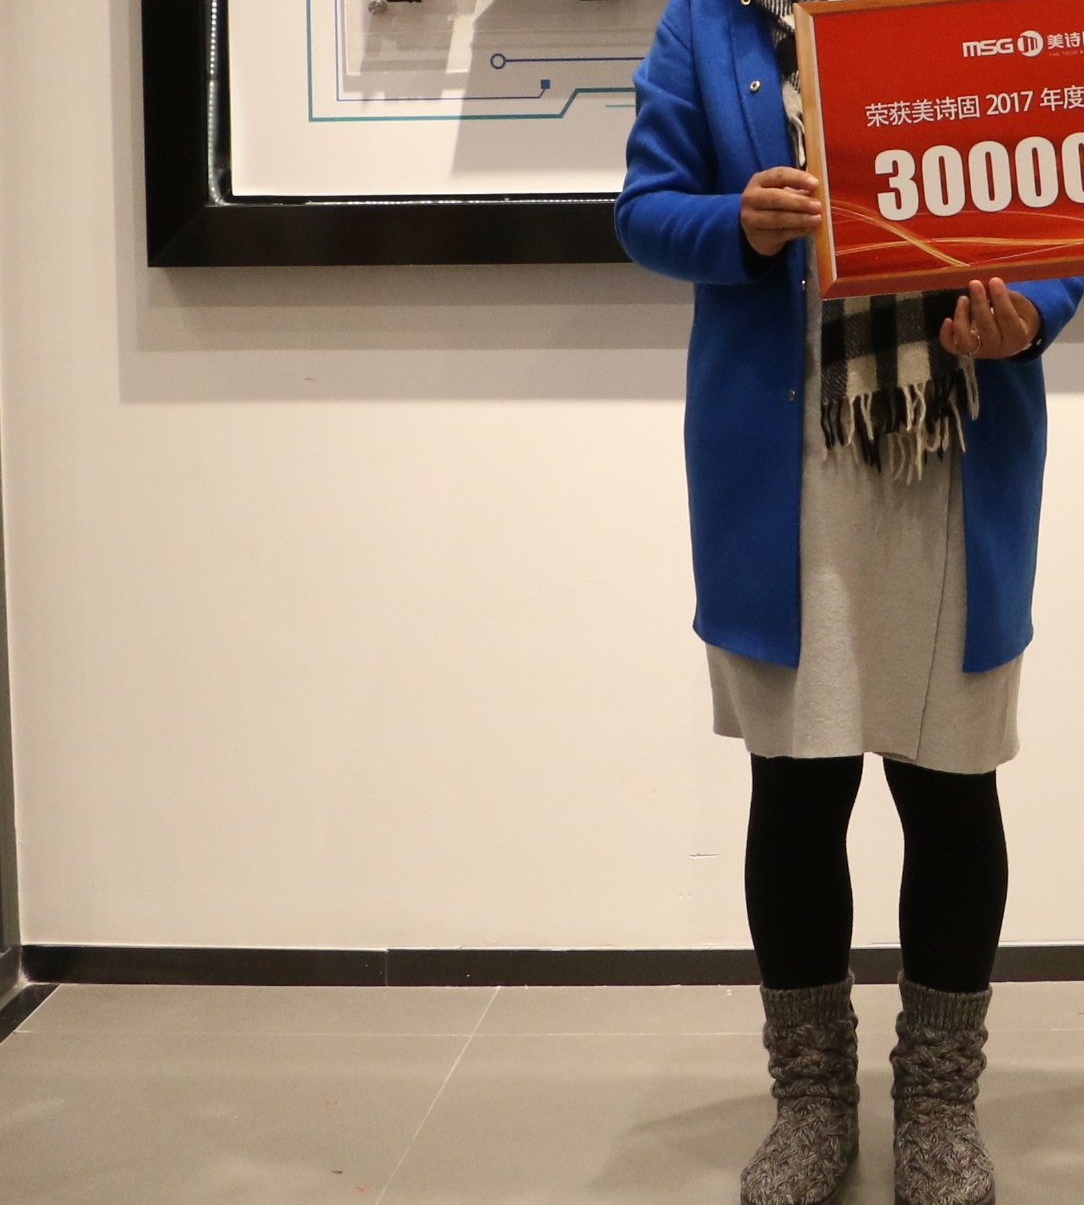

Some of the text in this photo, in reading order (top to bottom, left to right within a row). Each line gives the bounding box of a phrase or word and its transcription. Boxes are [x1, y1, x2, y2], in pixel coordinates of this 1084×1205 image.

[864, 95, 981, 127] 荣获美诗固
[985, 90, 1034, 116] 2017
